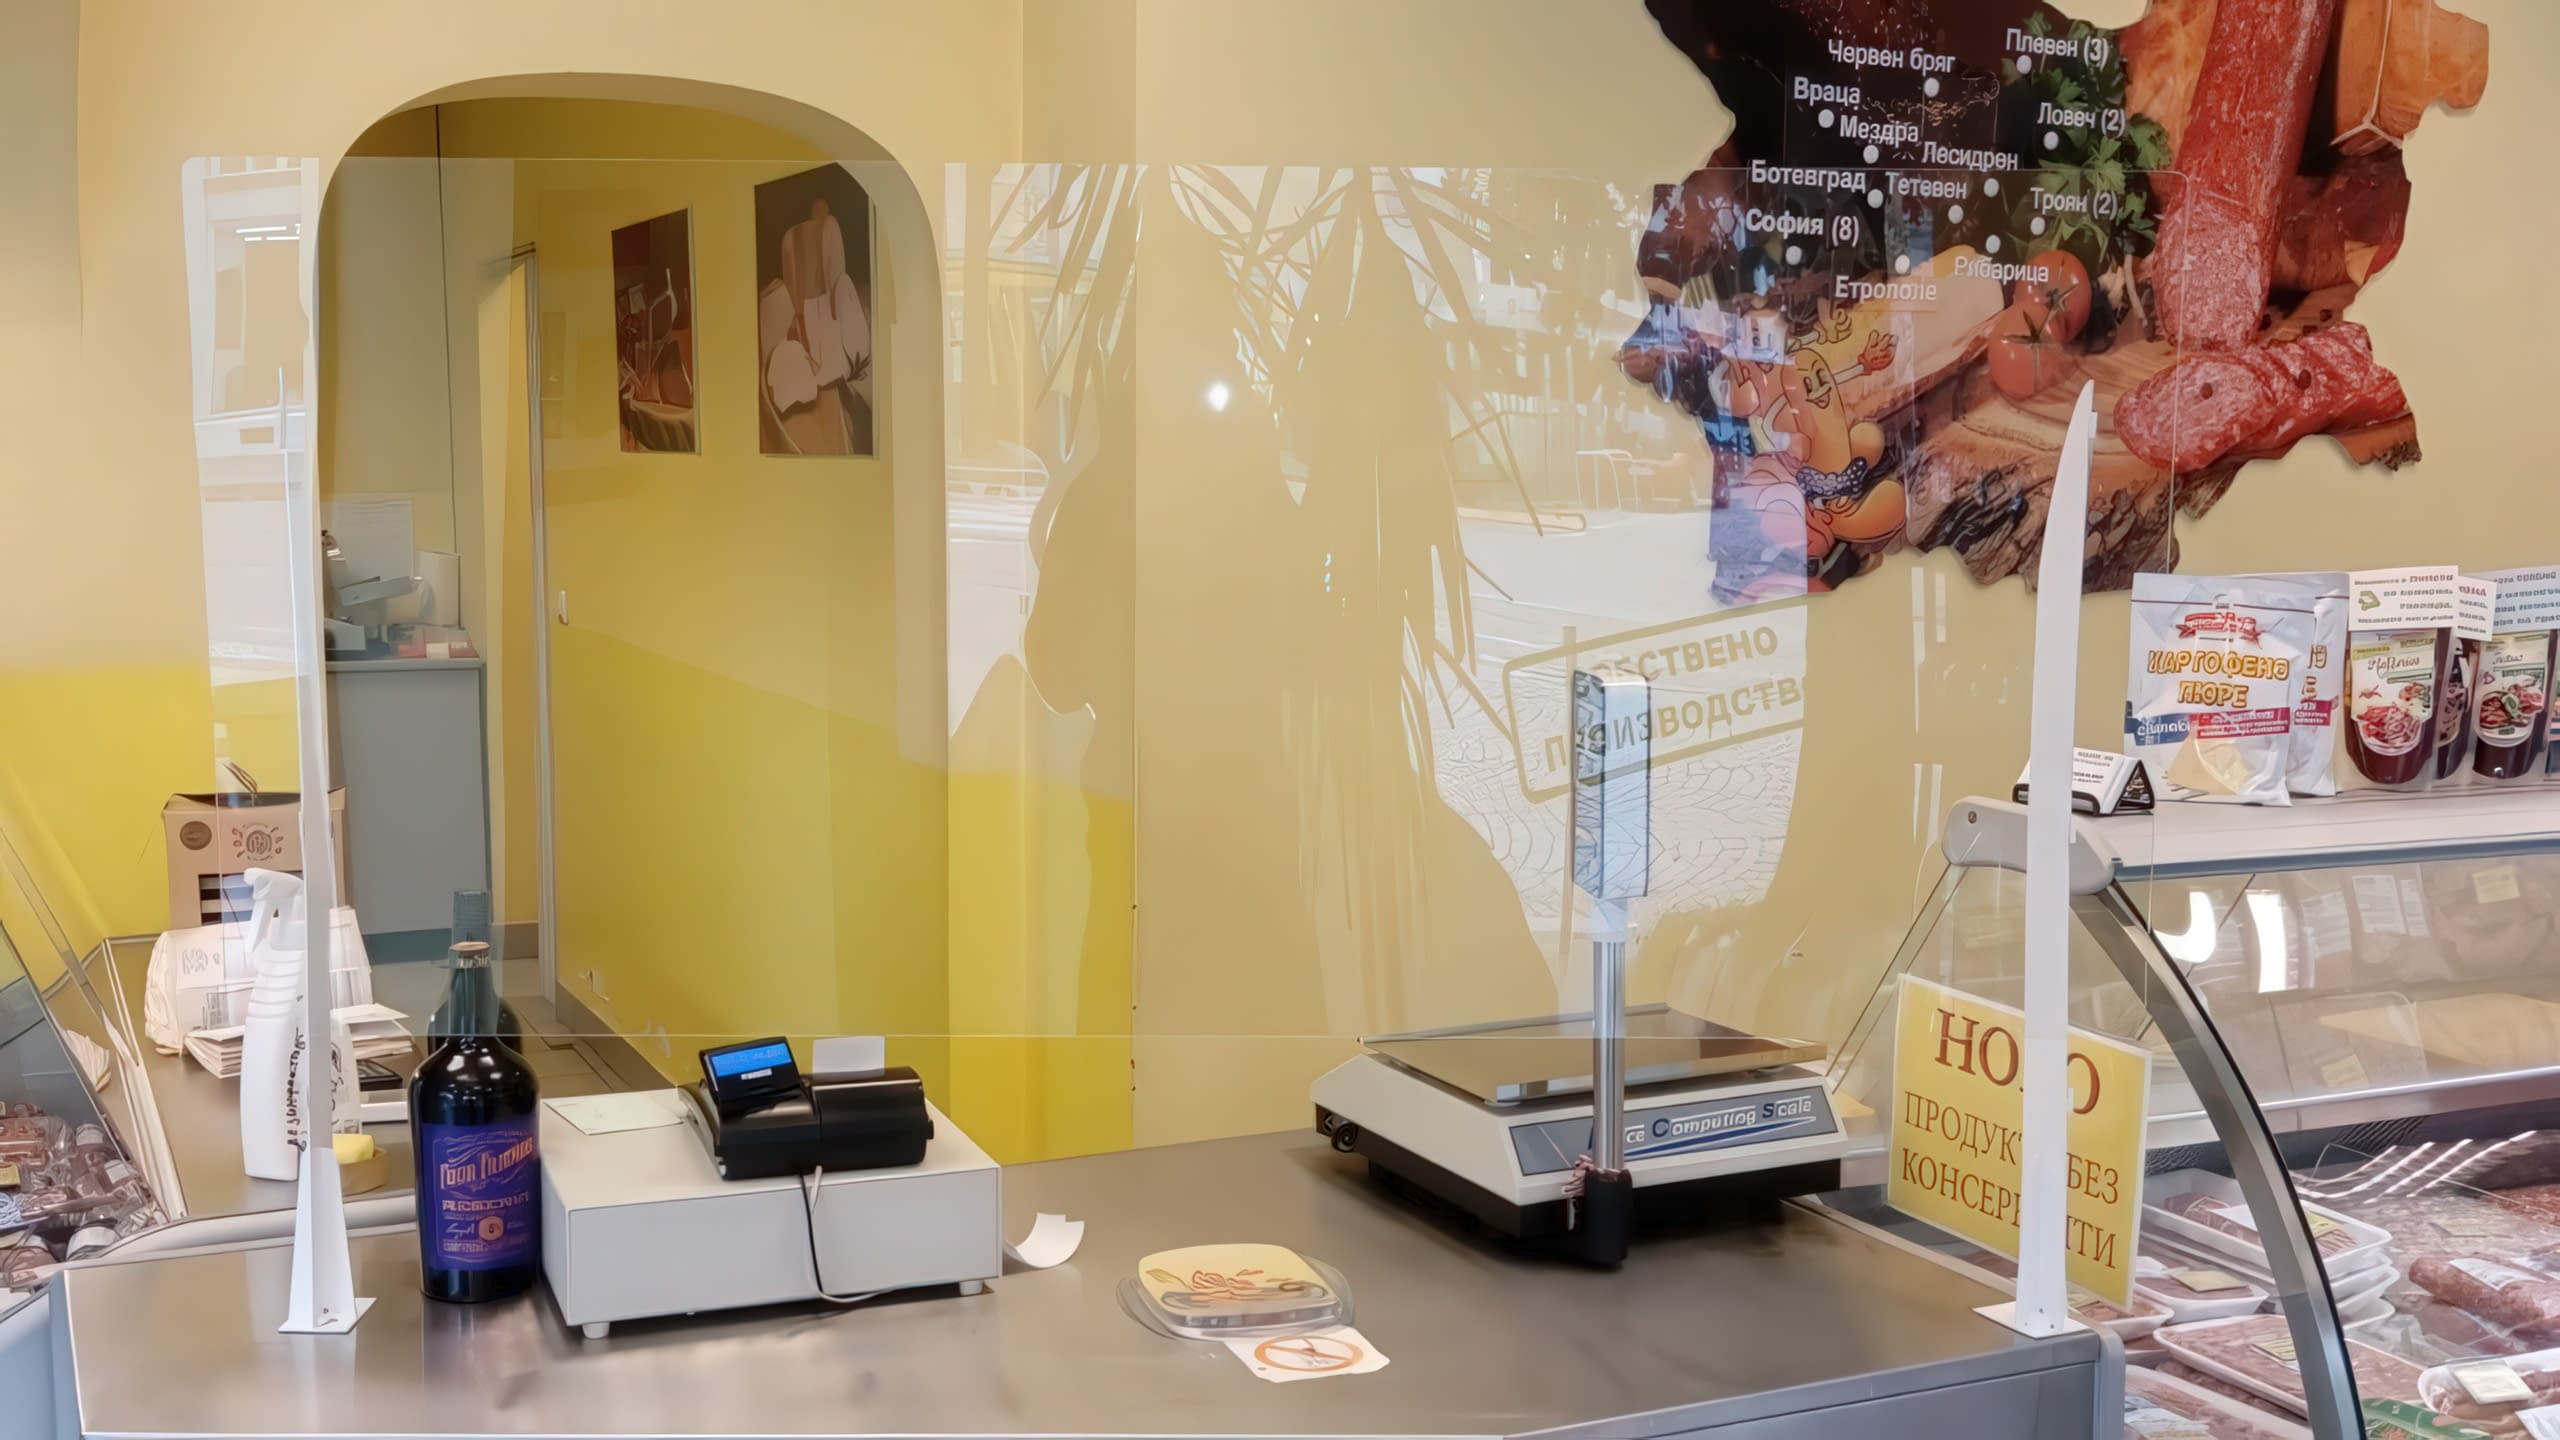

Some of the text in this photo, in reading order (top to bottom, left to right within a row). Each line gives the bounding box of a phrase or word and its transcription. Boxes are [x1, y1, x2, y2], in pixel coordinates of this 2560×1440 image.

[1828, 40, 1955, 77] Червен бряг
[2006, 28, 2109, 63] Плевен (3)
[1794, 77, 1861, 109] Враца
[1840, 116, 1919, 149] Мездра
[2037, 103, 2126, 135] Ловеч (2)
[1922, 141, 2018, 173] Лесидрен
[1751, 159, 1867, 193] Ботевград
[1886, 171, 1967, 200] Тетевен
[2031, 187, 2118, 219] Троян (2)
[1746, 209, 1860, 247] София (8)
[1835, 276, 1937, 303] Етрополе
[1934, 1008, 2101, 1115] НОО
[1653, 1107, 1757, 1138] Computing
[1763, 1096, 1813, 1120] Scale
[1904, 1091, 2120, 1205] ПРОДУК БЕЗ
[1901, 1148, 2117, 1270] КОНСЕРТИ
